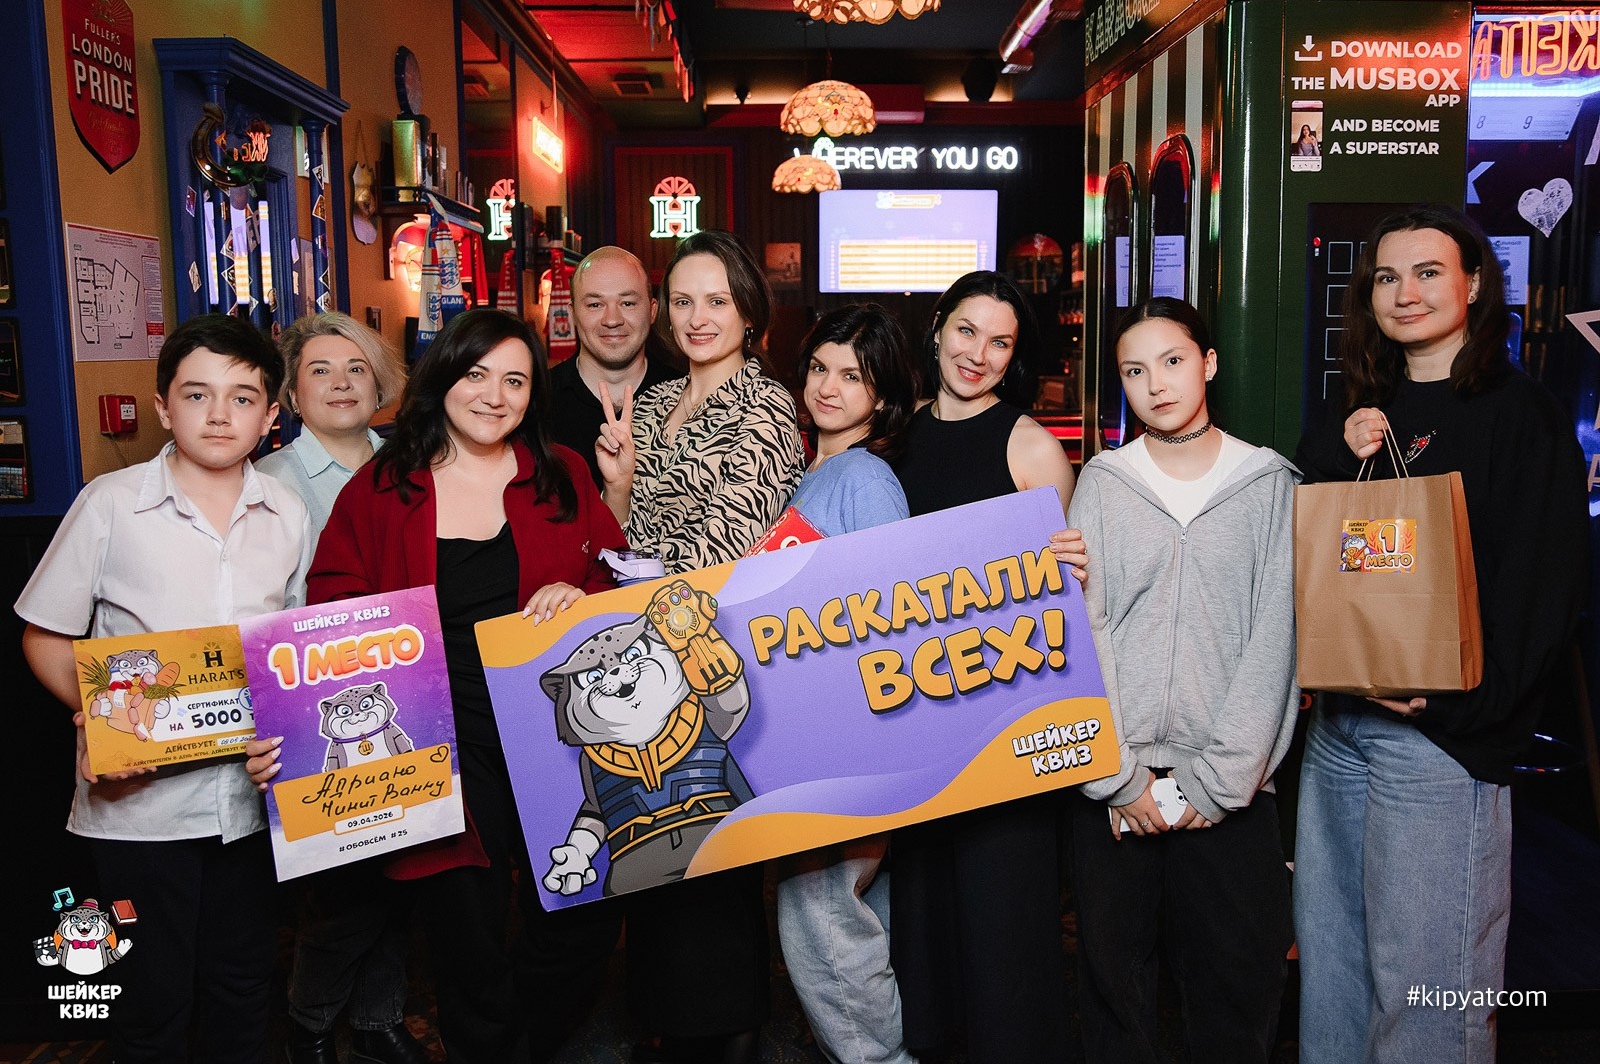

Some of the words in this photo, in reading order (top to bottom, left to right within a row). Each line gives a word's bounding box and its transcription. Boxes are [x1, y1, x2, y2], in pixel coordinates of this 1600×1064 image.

[84, 18, 121, 46] FULLER'S
[72, 33, 132, 74] LONDON
[1330, 40, 1462, 58] DOWNLOAD
[73, 59, 135, 114] PRIDE
[1291, 76, 1325, 90] THE
[1330, 67, 1461, 91] MUSBOX
[1425, 94, 1461, 107] APP
[1330, 119, 1367, 132] AND
[1371, 119, 1440, 133] BECOME
[1476, 115, 1486, 129] 8
[1523, 115, 1533, 130] 9
[931, 146, 978, 170] YOU
[986, 146, 1019, 170] GO
[1329, 141, 1342, 155] A
[1345, 142, 1440, 155] SUPERSTAR
[1380, 523, 1397, 553] 1
[1365, 553, 1413, 568] МЕСТО
[748, 546, 1065, 666] РАСКАТАЛИ
[293, 612, 349, 633] ШЕЙКЕР
[353, 605, 391, 623] КВИЗ
[271, 645, 297, 687] 1
[306, 627, 422, 682] МЕСТО
[857, 609, 1067, 715] ВСЕХ!
[188, 669, 245, 685] HARAT'S
[187, 697, 240, 711] СЕРТИФИКАТ
[169, 722, 184, 732] НА
[191, 708, 242, 729] 5000
[165, 740, 216, 754] ДЕЙСТВУЕТ:
[1011, 718, 1101, 758] ШЕЙКЕР
[1030, 744, 1093, 777] КВИЗ
[347, 811, 394, 828] 09.04.2026
